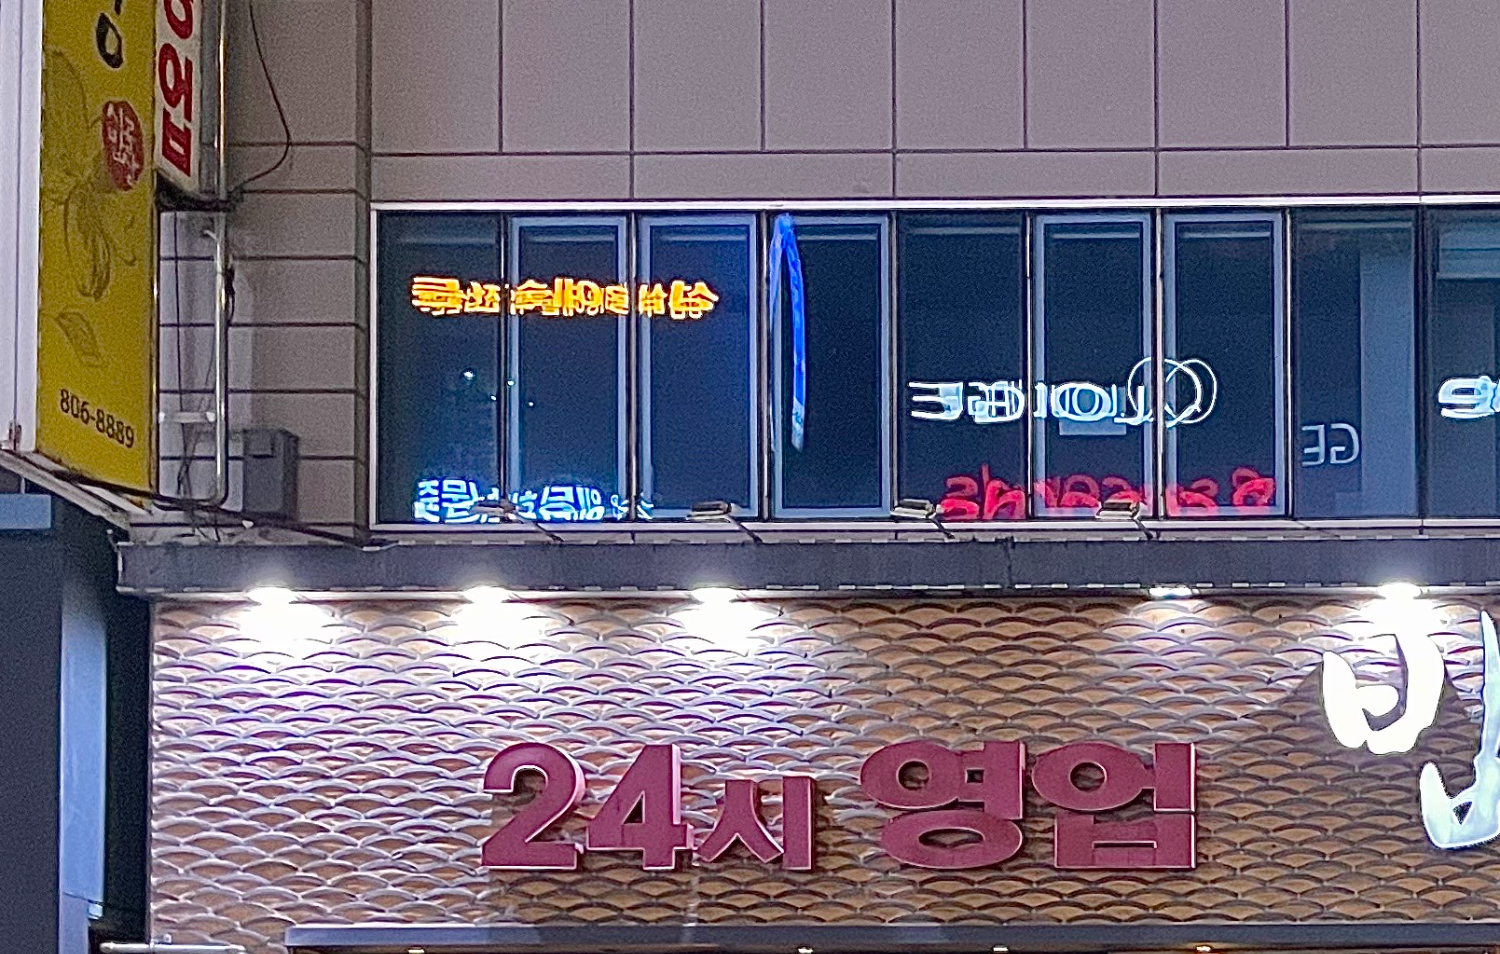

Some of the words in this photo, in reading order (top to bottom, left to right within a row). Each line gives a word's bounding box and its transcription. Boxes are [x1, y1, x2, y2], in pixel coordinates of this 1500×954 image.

[60, 388, 135, 449] 806-8889
[481, 741, 816, 870] 24시
[859, 740, 1198, 870] 영업
